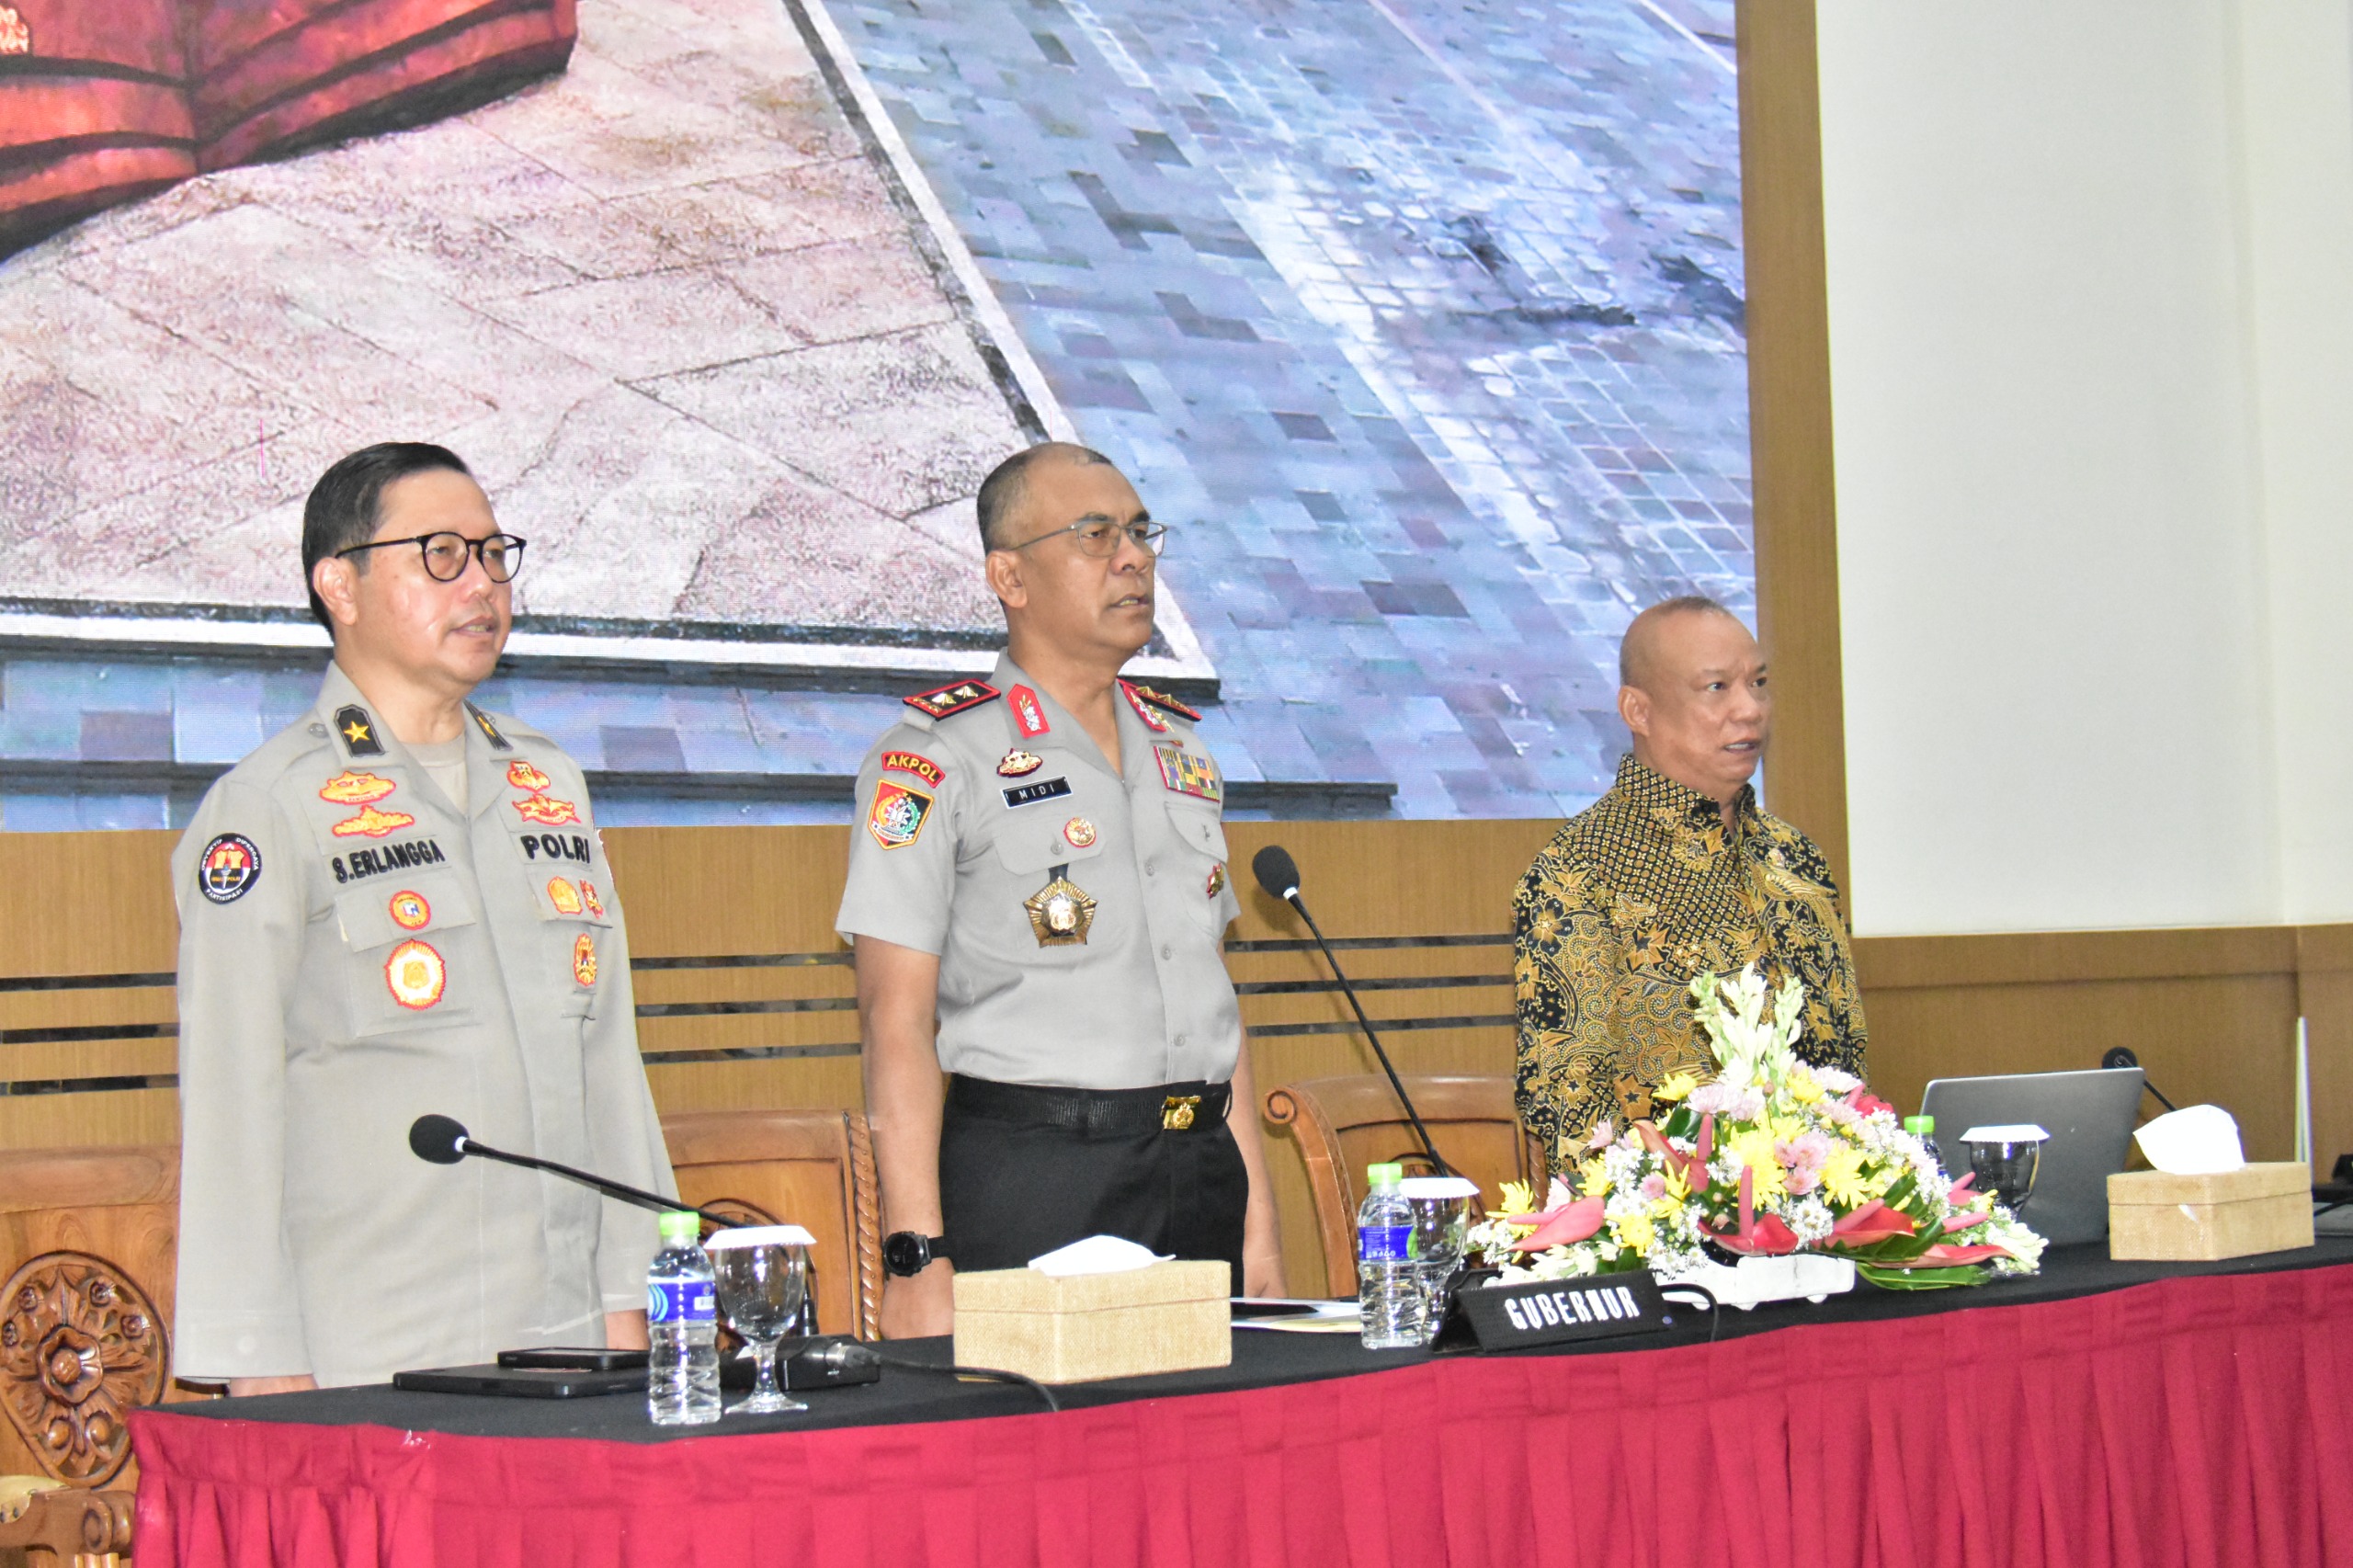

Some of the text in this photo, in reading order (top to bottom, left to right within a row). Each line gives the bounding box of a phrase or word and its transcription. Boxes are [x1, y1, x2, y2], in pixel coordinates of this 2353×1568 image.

[887, 754, 937, 782] AKPOL
[1018, 783, 1055, 800] MIDI
[332, 838, 446, 883] S.ERLANGGA
[520, 834, 590, 864] POLRI
[1504, 1286, 1641, 1330] GUBERNUR
